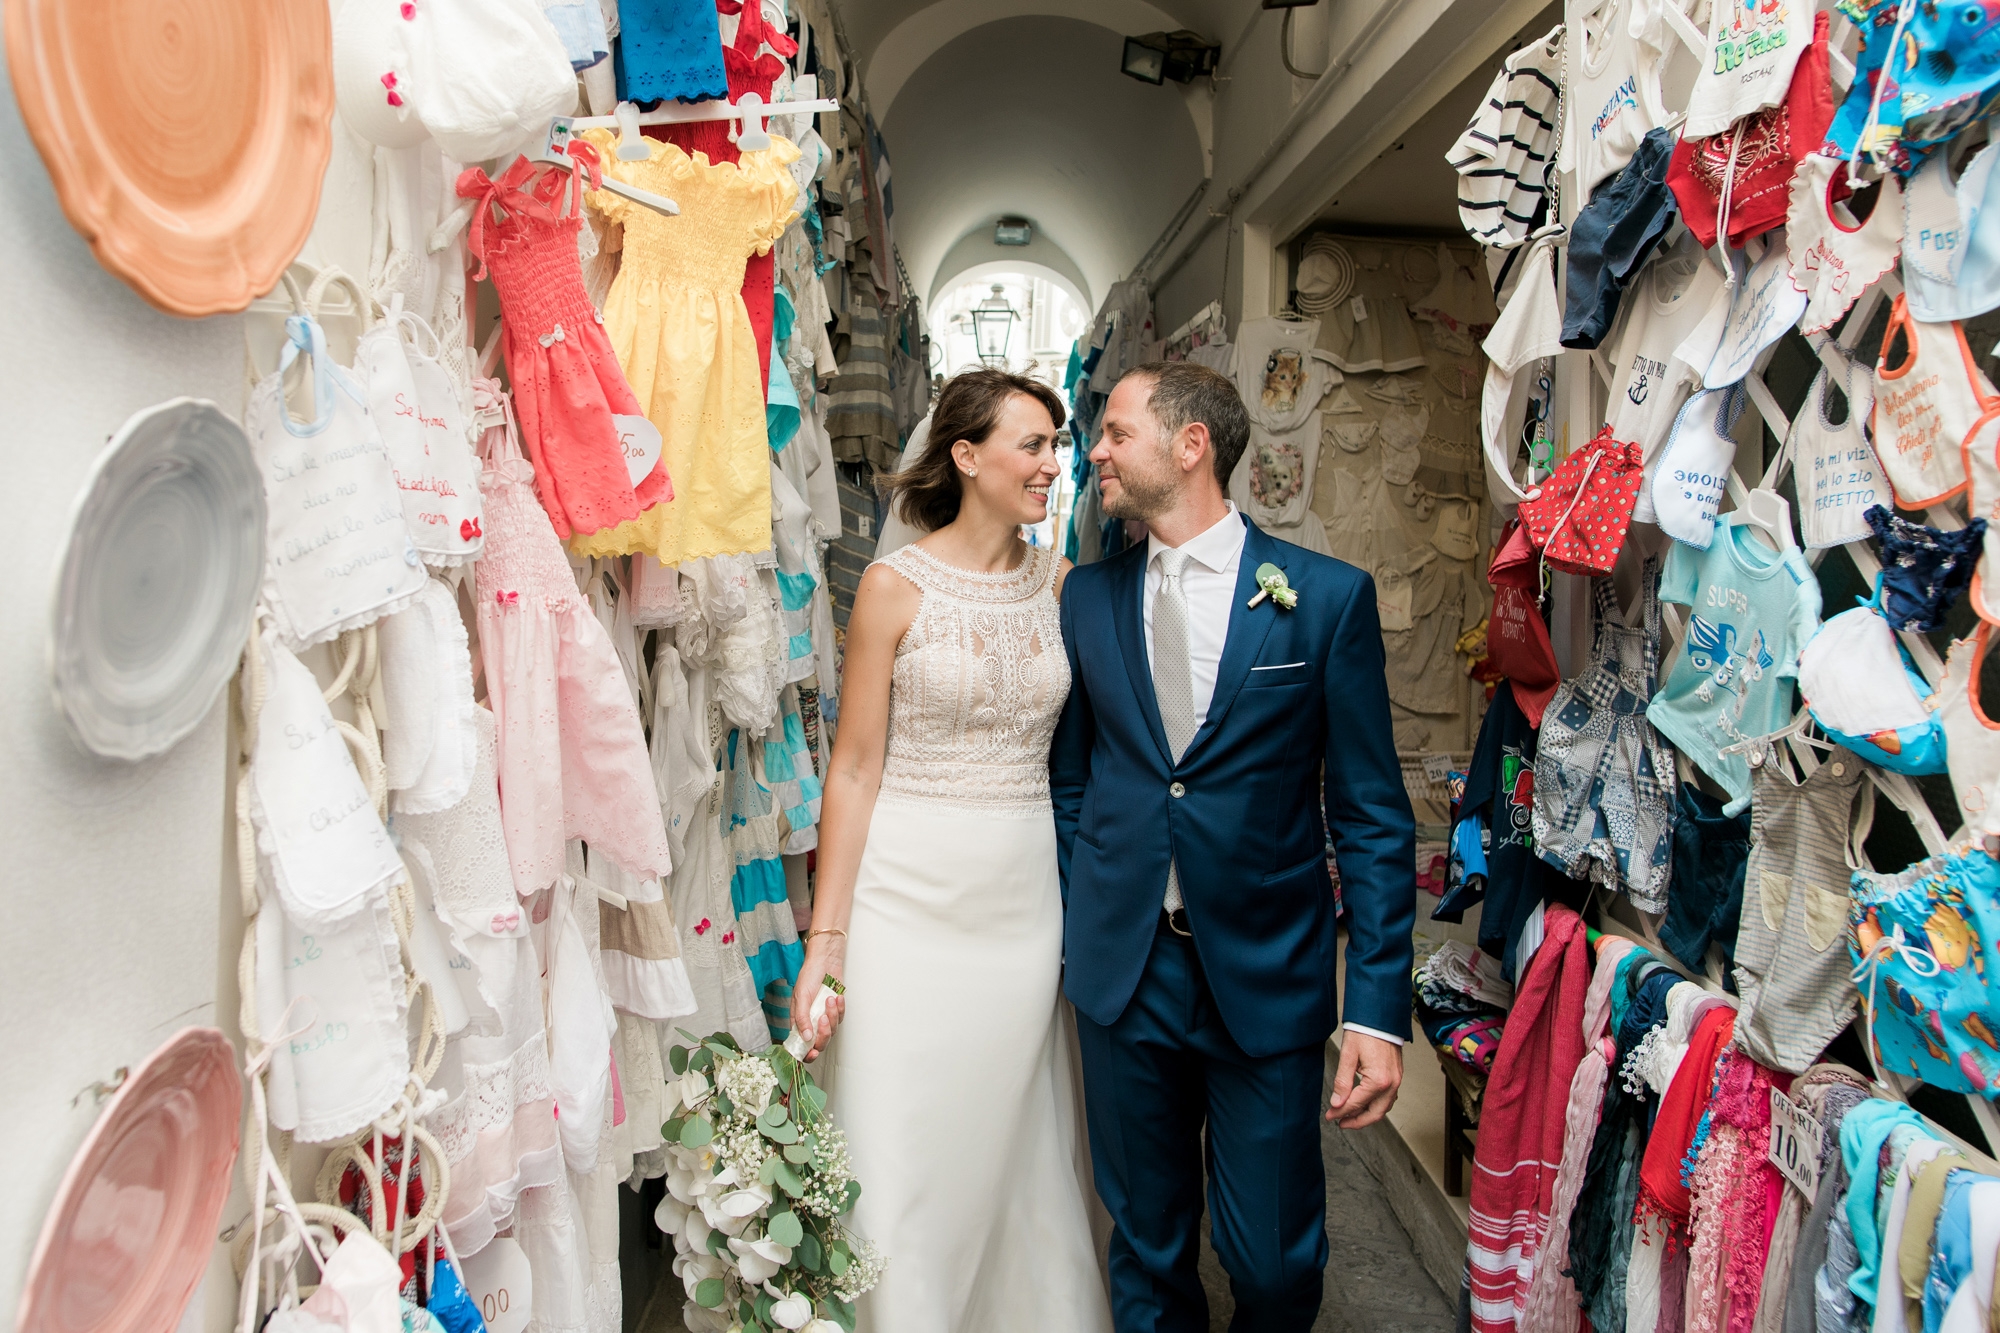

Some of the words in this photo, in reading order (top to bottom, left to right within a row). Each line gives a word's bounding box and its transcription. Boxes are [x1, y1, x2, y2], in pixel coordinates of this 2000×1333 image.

[1714, 41, 1747, 75] Re
[616, 431, 646, 459] 5.00
[1848, 468, 1873, 484] zio
[1706, 584, 1748, 617] SUPER
